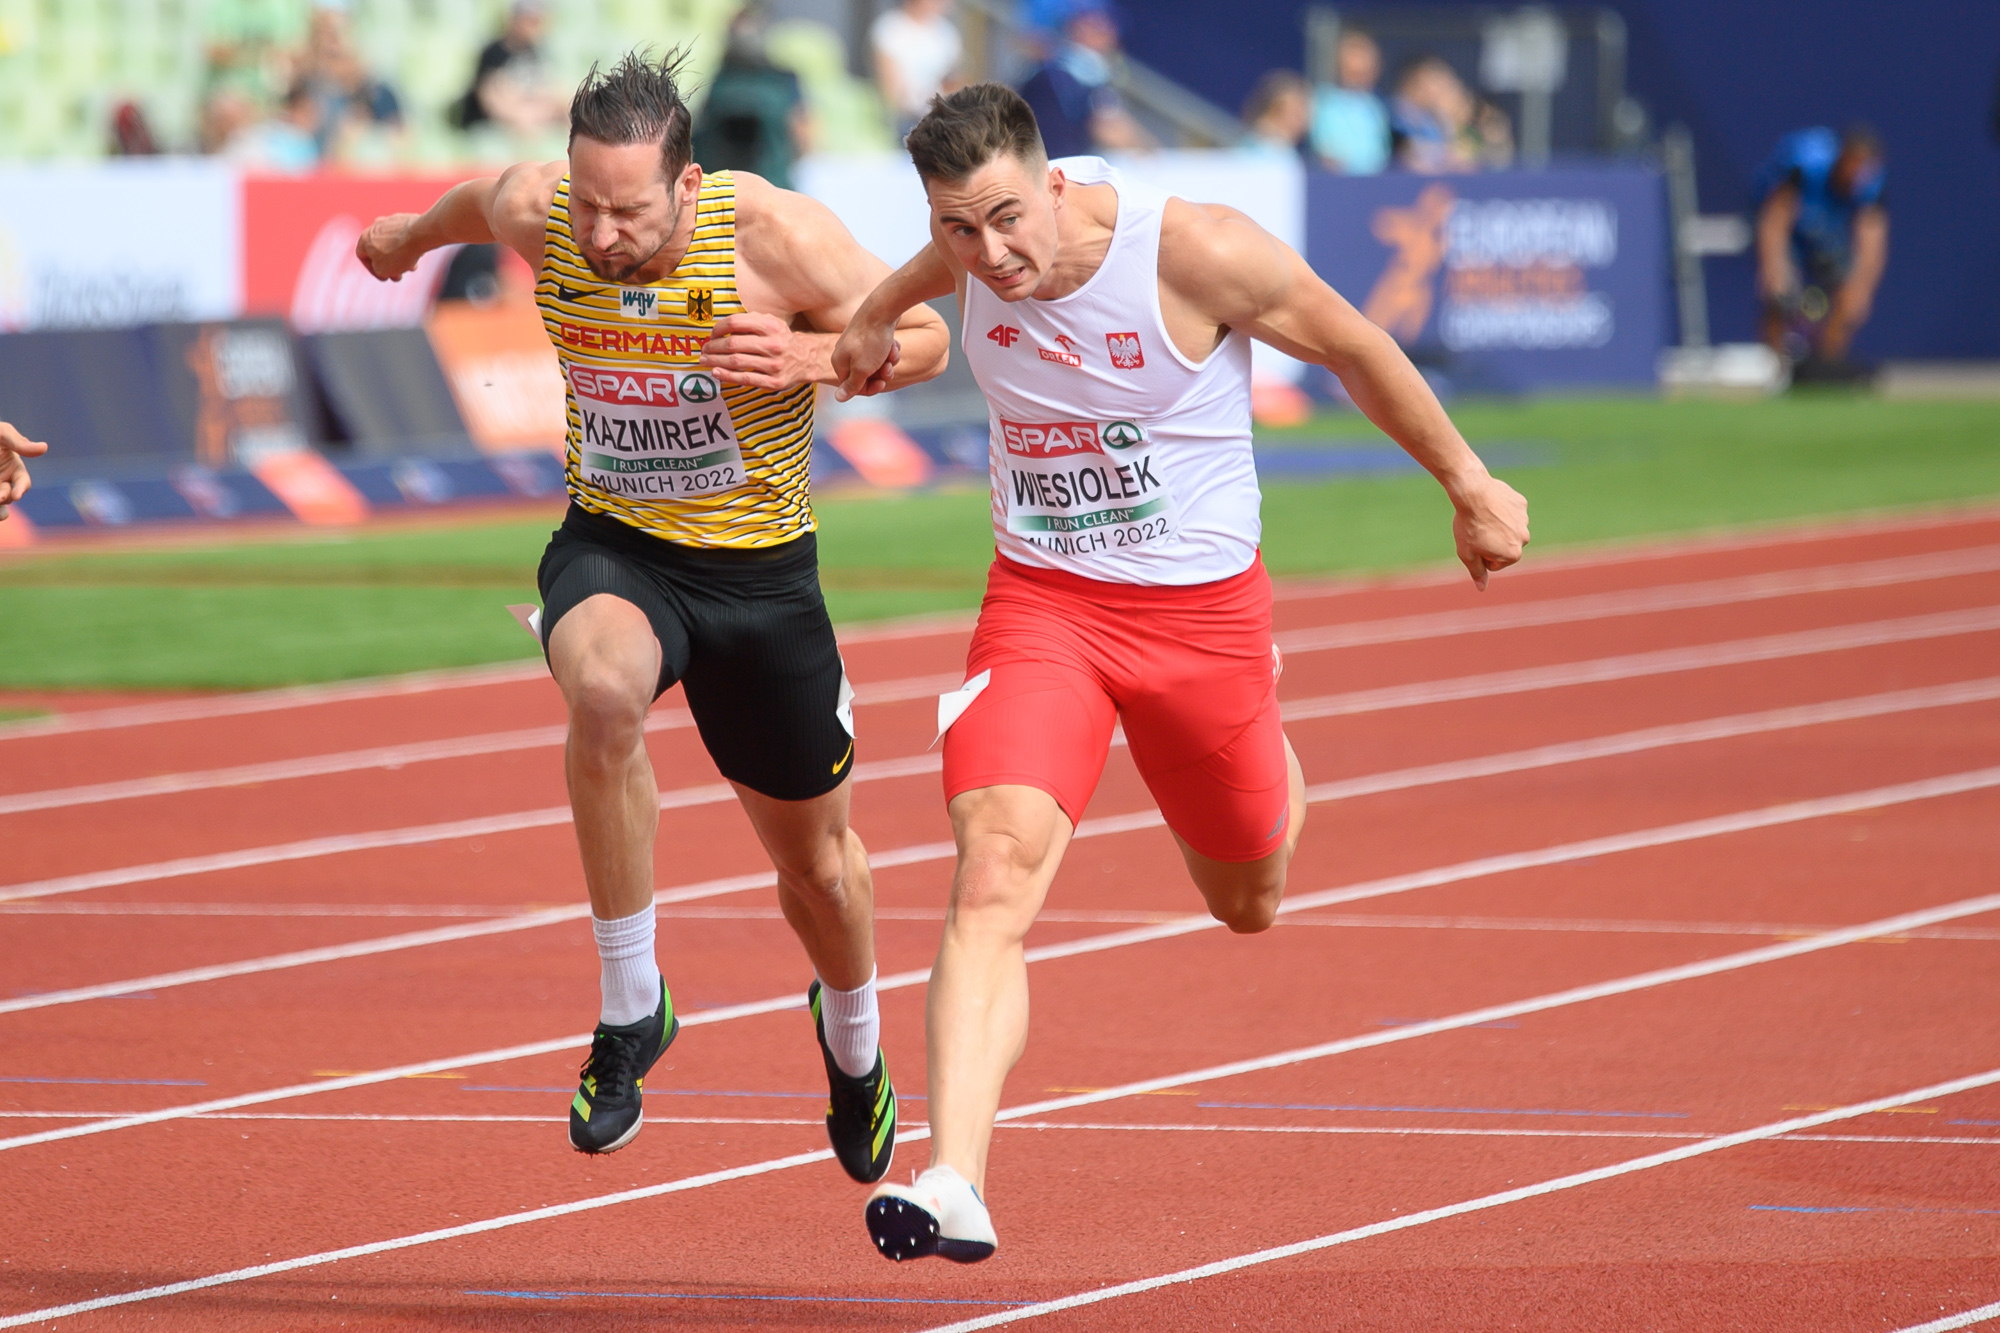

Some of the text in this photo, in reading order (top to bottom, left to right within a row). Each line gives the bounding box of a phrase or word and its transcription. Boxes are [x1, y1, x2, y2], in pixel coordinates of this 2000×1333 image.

[560, 322, 711, 356] GERMANY
[987, 324, 1020, 348] 4F
[1041, 350, 1080, 366] ORLEN
[572, 370, 675, 403] SPAR
[582, 409, 731, 452] KAZMIREK
[1004, 426, 1100, 453] SPAR
[612, 458, 618, 471] I
[619, 459, 650, 472] RUN
[591, 467, 737, 494] MUNICH 2022
[1011, 455, 1161, 509] WIESIOLEK
[1046, 517, 1051, 530] I
[1053, 518, 1080, 531] RUN
[1113, 517, 1170, 547] 2022
